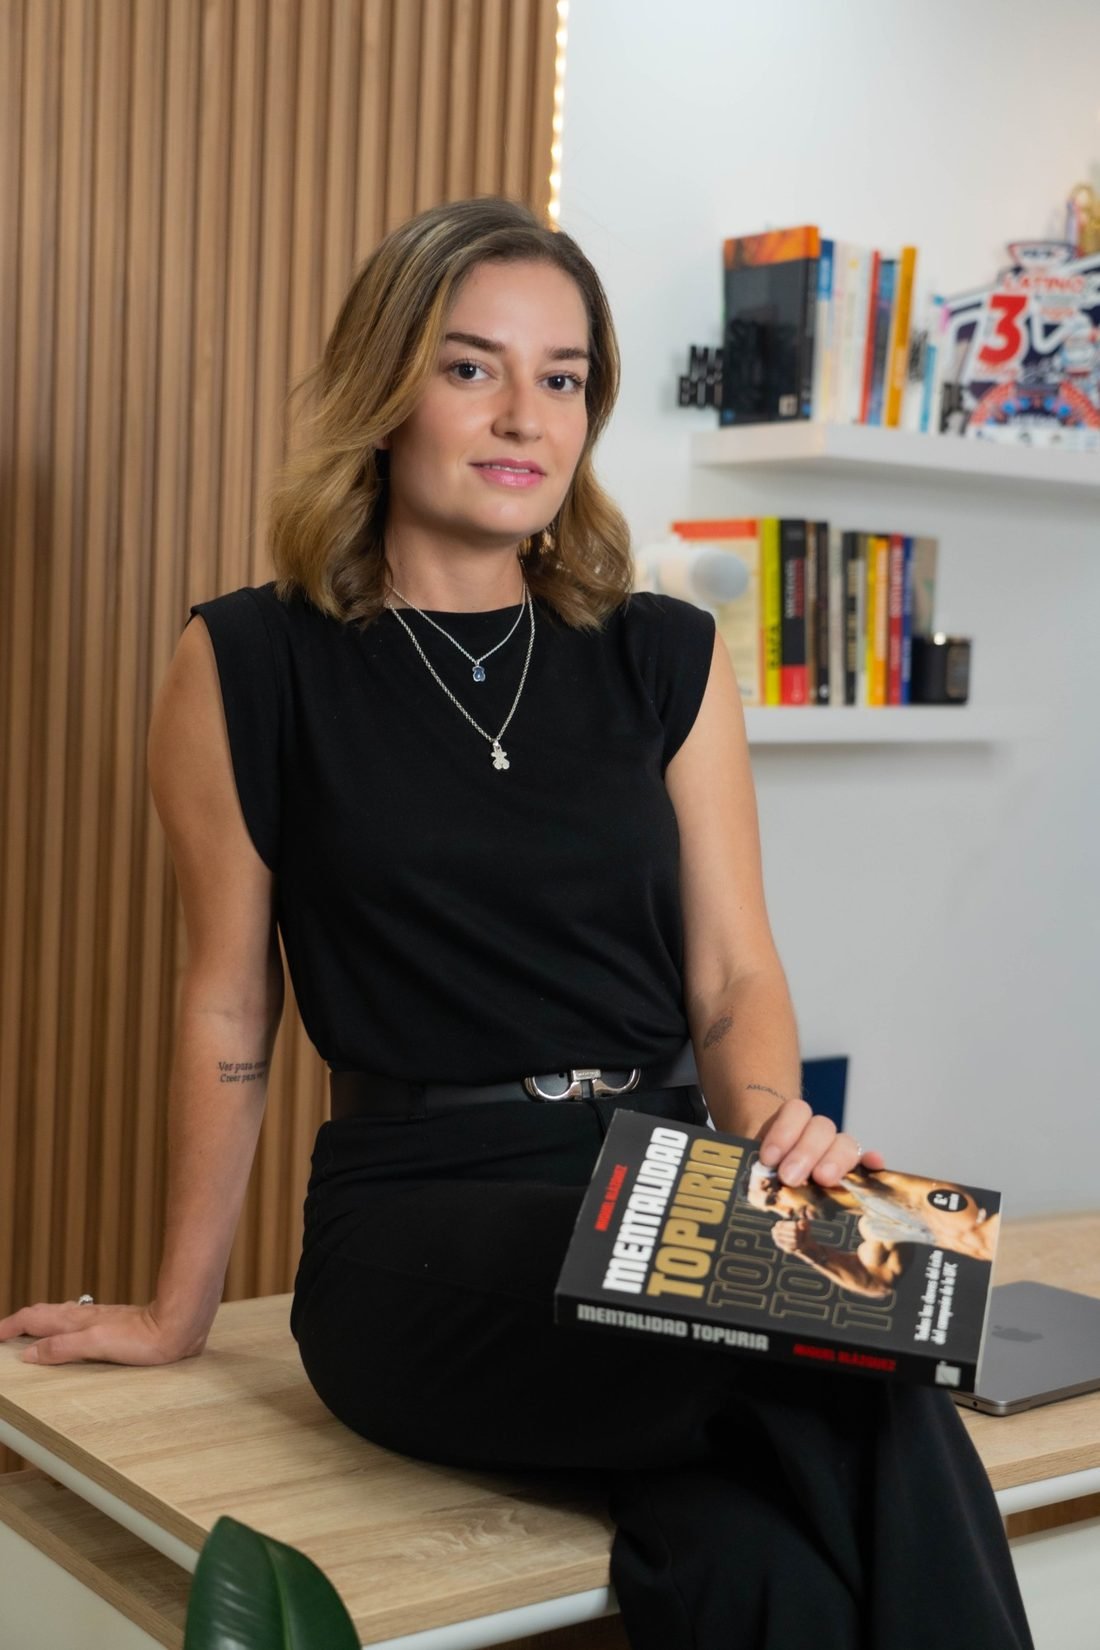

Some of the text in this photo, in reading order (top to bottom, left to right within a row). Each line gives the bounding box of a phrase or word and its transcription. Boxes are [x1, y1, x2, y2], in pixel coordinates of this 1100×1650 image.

[977, 295, 1028, 366] 3
[602, 1127, 688, 1294] MENTALIDAD
[646, 1139, 744, 1298] TOPURIA
[576, 1303, 770, 1351] MENTALIDAD TOPURIA
